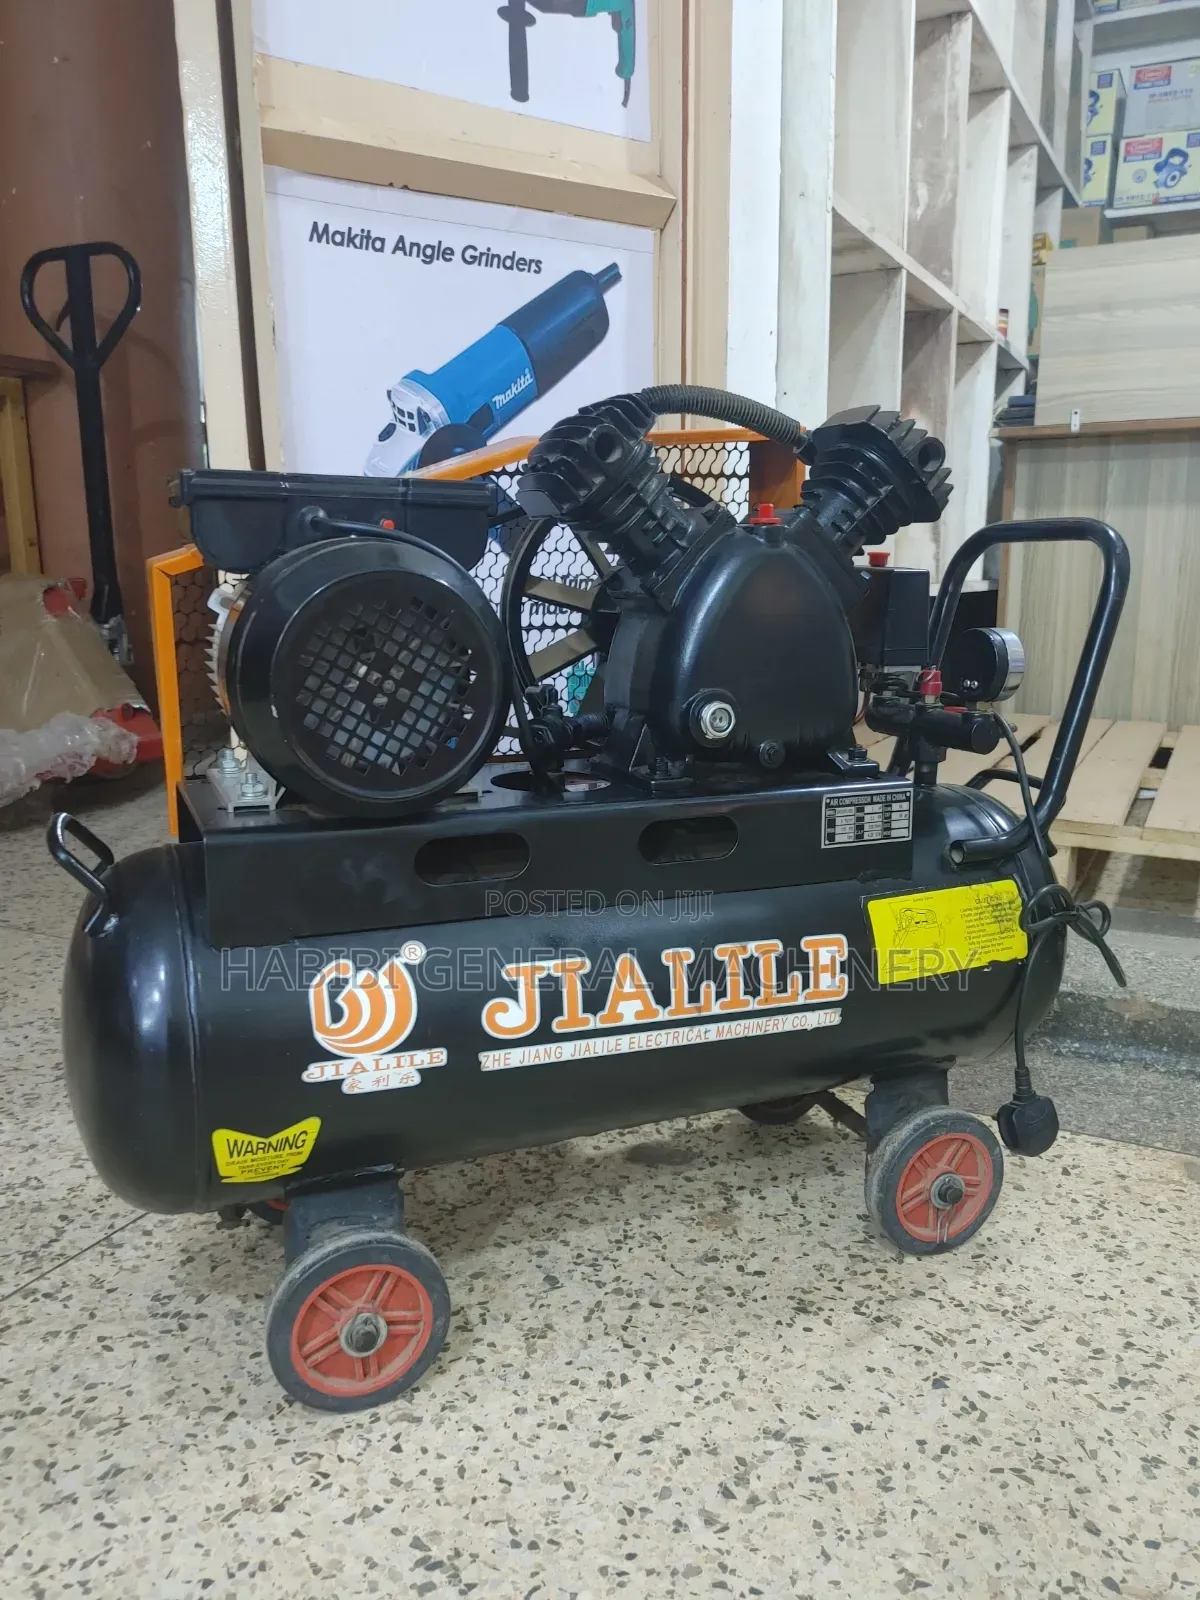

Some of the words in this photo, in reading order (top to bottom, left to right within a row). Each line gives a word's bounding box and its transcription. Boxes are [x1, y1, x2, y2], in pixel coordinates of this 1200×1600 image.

[308, 220, 386, 253] Makita
[391, 234, 455, 265] Angle
[461, 244, 543, 275] Grinders
[492, 367, 535, 410] makita
[829, 798, 838, 806] AIR
[839, 796, 871, 805] COMPRESSOR
[872, 794, 886, 802] MADE
[892, 793, 906, 801] CHINA
[483, 935, 847, 1037] JIALILE
[482, 1052, 511, 1069] ZHE
[519, 1045, 563, 1065] JIANG
[570, 1039, 623, 1058] JIALILE
[628, 1027, 710, 1050] ELECTRICAL
[716, 1017, 788, 1039] MACHINERY
[791, 1014, 814, 1028] CO.,
[306, 1050, 444, 1080] JIALILE
[345, 1071, 415, 1092] 家利乐
[226, 1130, 308, 1158] WARNING
[226, 1159, 247, 1167] DRAIN
[251, 1154, 283, 1163] MOISTURE
[240, 1164, 285, 1175] PREVENT
